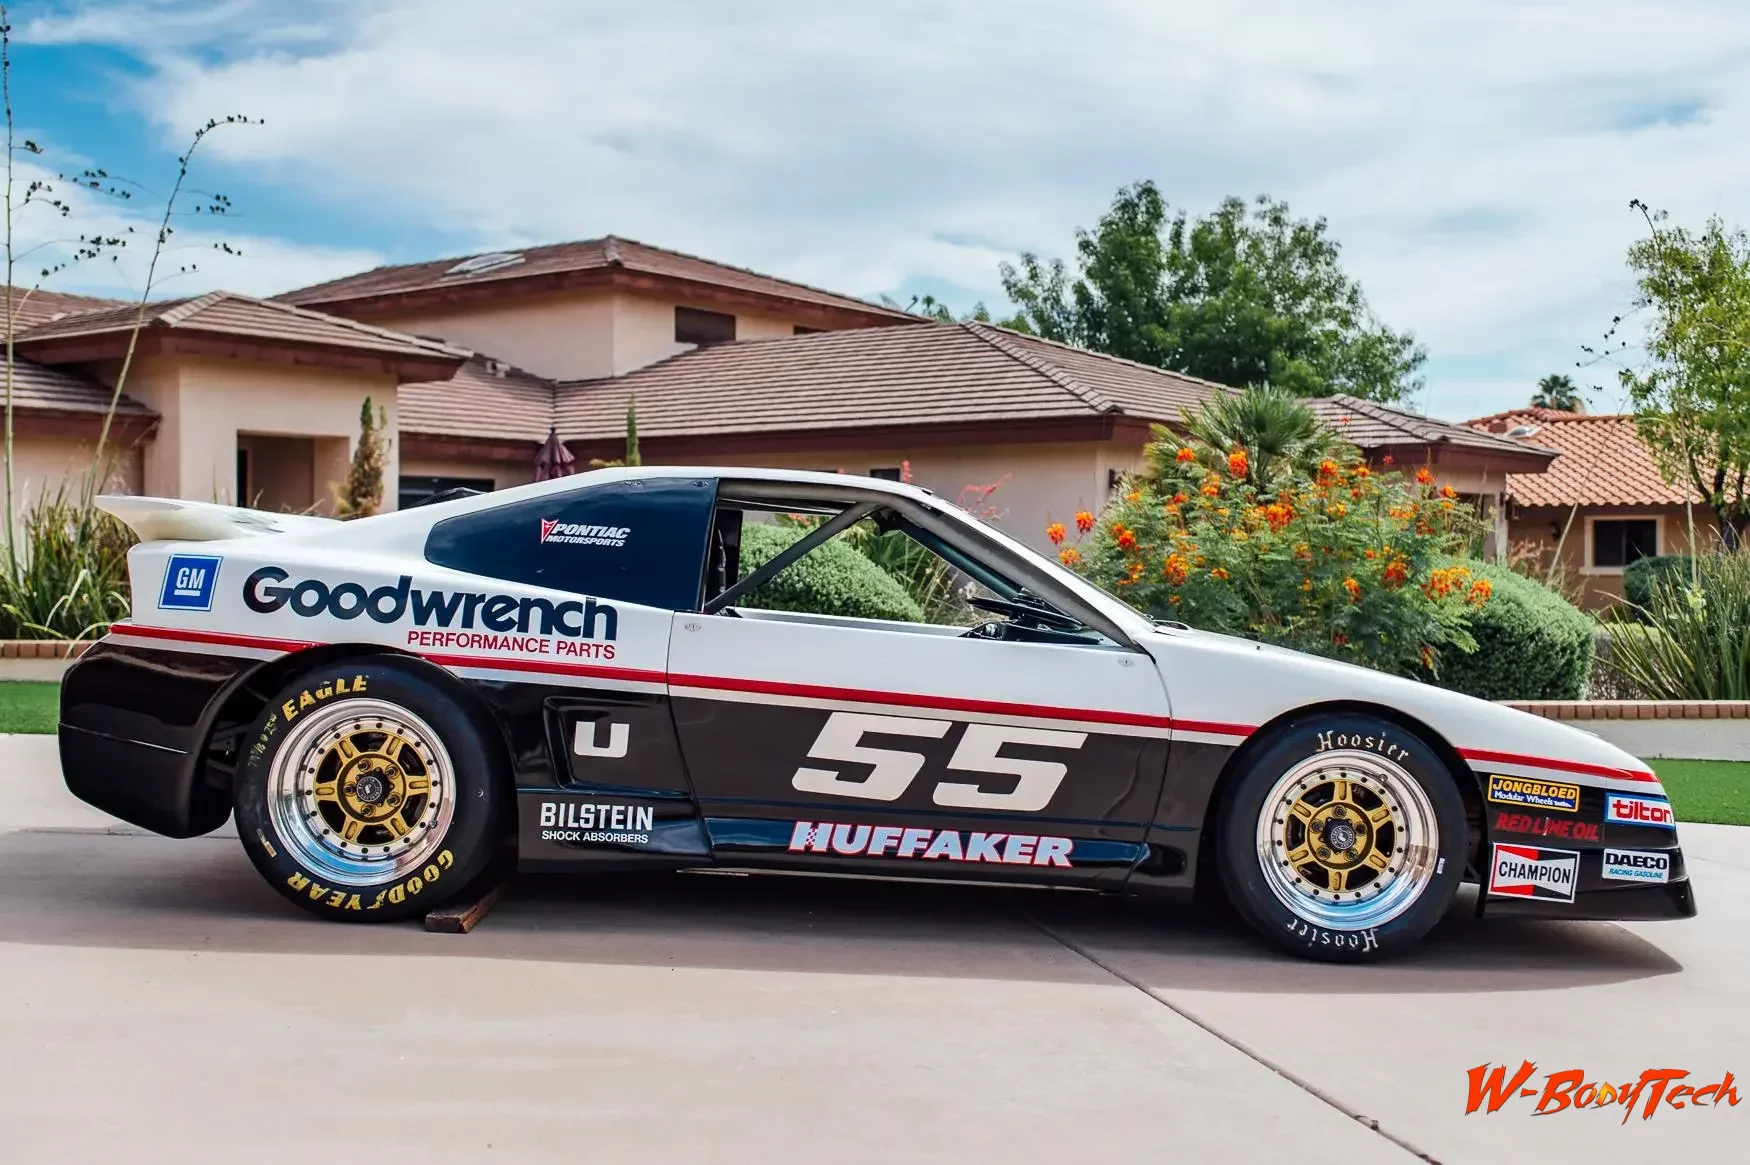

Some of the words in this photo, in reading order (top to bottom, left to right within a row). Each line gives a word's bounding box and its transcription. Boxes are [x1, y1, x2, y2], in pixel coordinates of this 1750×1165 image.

[545, 535, 625, 547] MOTORSPORTS
[551, 523, 631, 539] PONTIAC
[176, 567, 206, 589] GM
[242, 566, 618, 641] Goodwrench
[407, 630, 551, 654] PERFORMANCE
[556, 640, 616, 660] PARTS
[282, 674, 369, 722] EAGLE
[1316, 729, 1409, 761] Hoosier
[791, 711, 1089, 812] 55
[1492, 780, 1577, 800] JONGBLOED
[1494, 790, 1525, 803] Modular
[1526, 794, 1554, 807] Wheels
[540, 802, 654, 831] BILSTEIN
[1612, 799, 1674, 824] tilton
[541, 830, 581, 841] SHOCK
[582, 832, 649, 844] ABSORBERS
[788, 820, 1074, 868] HUFFAKER
[1571, 822, 1600, 841] OIL
[1498, 860, 1572, 885] CHAMPION
[1604, 852, 1668, 870] DAECO
[1608, 867, 1633, 877] RACING
[1634, 870, 1663, 879] GASOLINE
[286, 849, 454, 911] GOODYEAR
[1286, 918, 1379, 953] Hoosier
